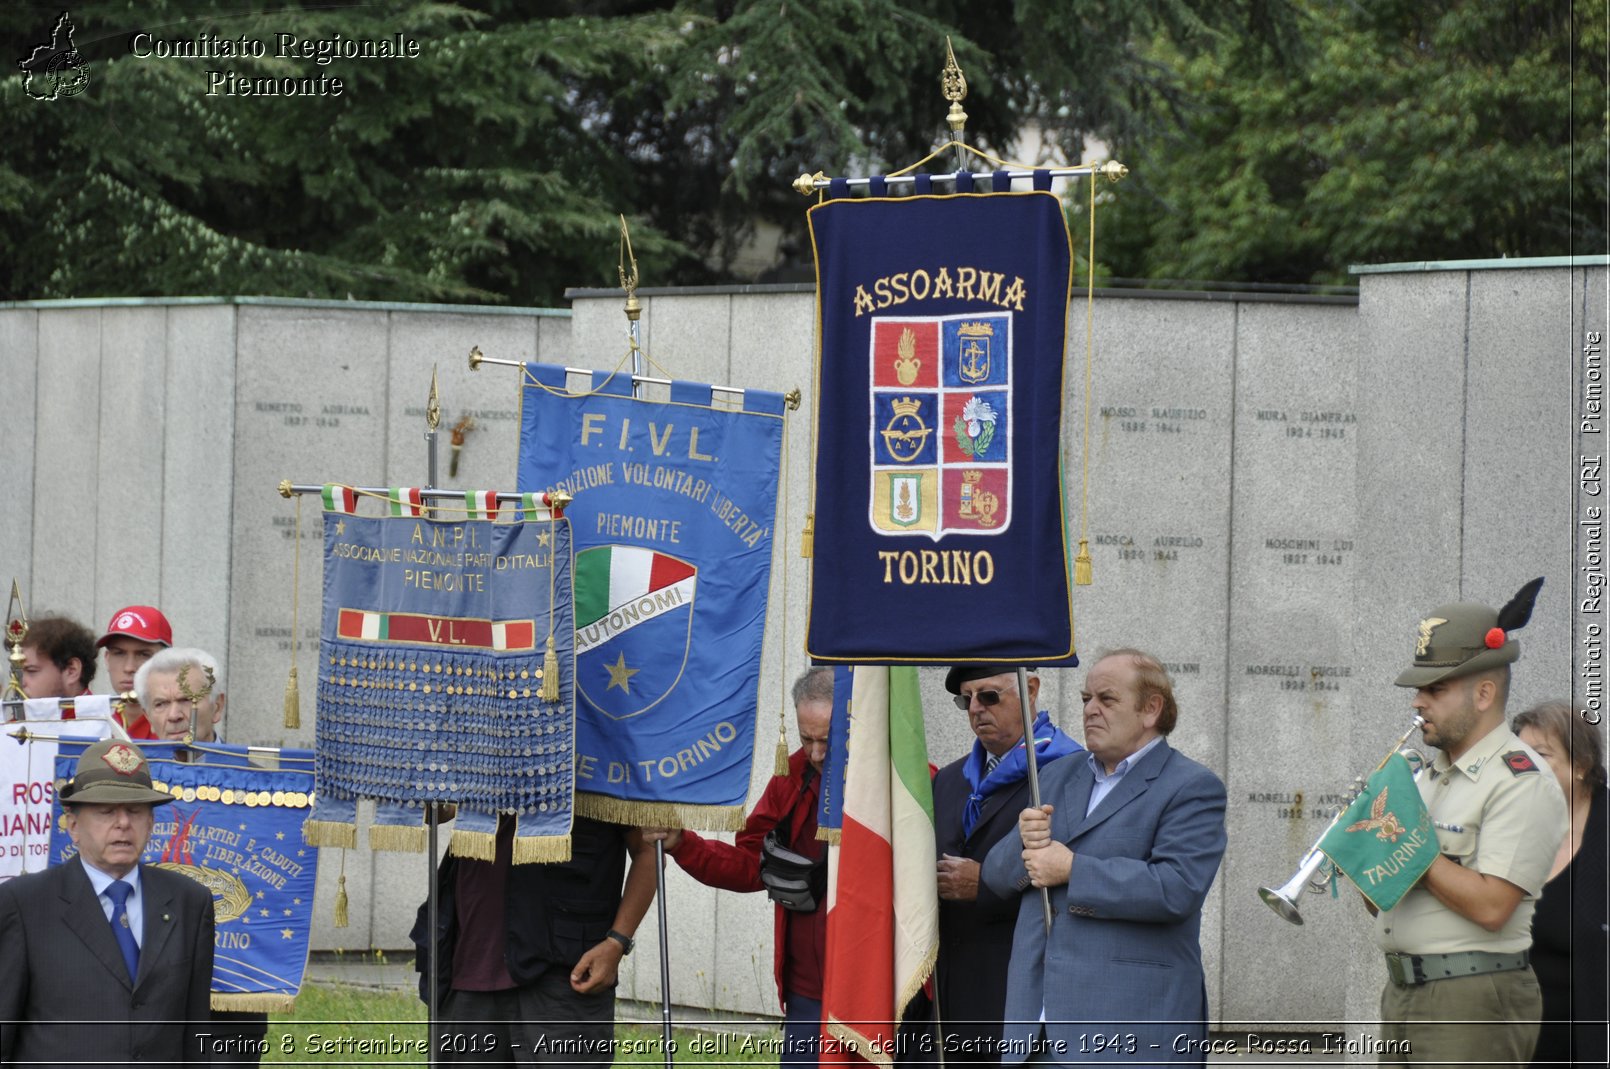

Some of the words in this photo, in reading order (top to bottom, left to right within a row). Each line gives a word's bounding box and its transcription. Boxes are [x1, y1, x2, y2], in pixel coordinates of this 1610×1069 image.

[854, 266, 1027, 317] ASSOARMA
[1257, 410, 1288, 421] MURA
[622, 461, 711, 503] VOLONTARI
[597, 512, 682, 544] PIEMONTE
[1095, 535, 1134, 546] MOSCA
[1153, 537, 1204, 548] AURELIO
[1265, 539, 1320, 551] MOSCHINI
[404, 568, 484, 593] PIEMONTE
[878, 550, 995, 585] TORINO
[576, 586, 683, 650] AUTONOMI
[607, 761, 631, 784] DI
[638, 722, 737, 782] TORINO
[10, 846, 24, 857] DI
[182, 840, 196, 854] DI
[206, 844, 288, 891] LIBERAZIONE
[187, 824, 242, 847] MARTIRI
[245, 838, 257, 851] E
[260, 846, 304, 879] CADUTI
